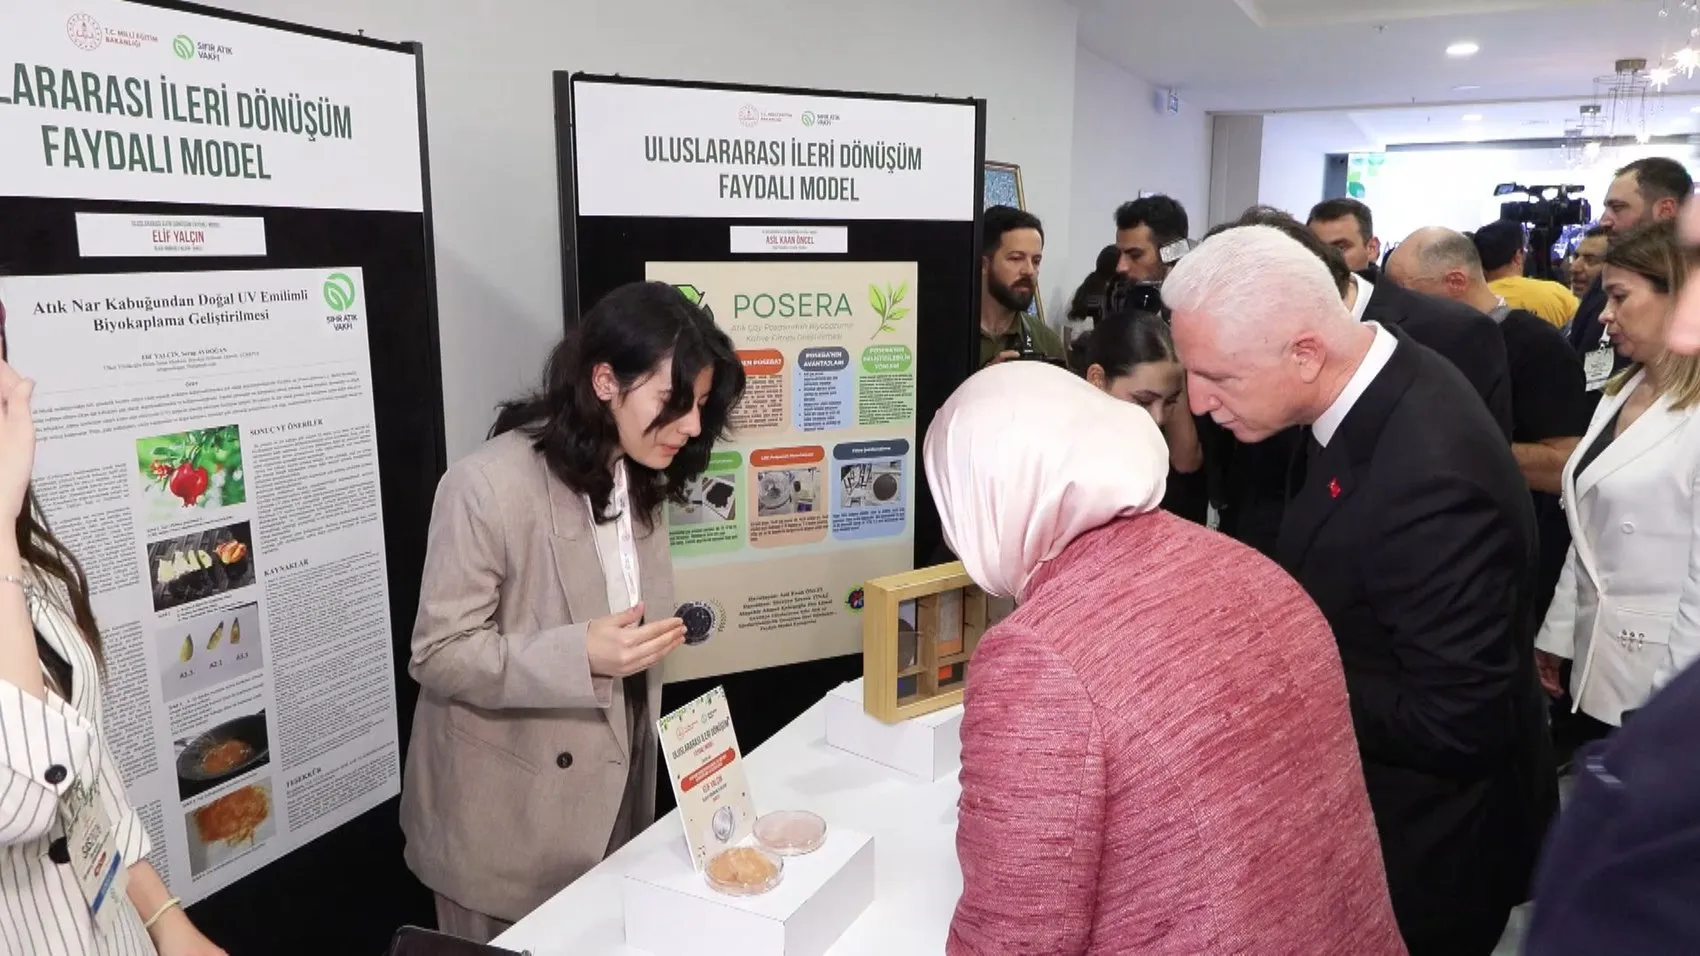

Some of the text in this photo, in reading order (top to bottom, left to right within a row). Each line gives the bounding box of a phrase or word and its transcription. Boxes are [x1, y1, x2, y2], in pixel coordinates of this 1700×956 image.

[216, 45, 232, 54] ATIK
[0, 62, 353, 142] ARARASI İLERİ DÖNÜŞÜM
[40, 124, 272, 180] FAYDALI MODEL
[644, 135, 922, 174] ULUSLARARASI İLERİ DÖNÜŞÜM
[719, 174, 860, 202] FAYDALI MODEL
[152, 228, 205, 246] ELİF YALÇIN
[780, 236, 796, 244] KAAN
[33, 289, 308, 315] Atık Nar Kabuğundan Doğal UV Emilimli
[734, 292, 853, 319] POSERA
[93, 309, 270, 334] Biyokaplama Geliştirilmesi
